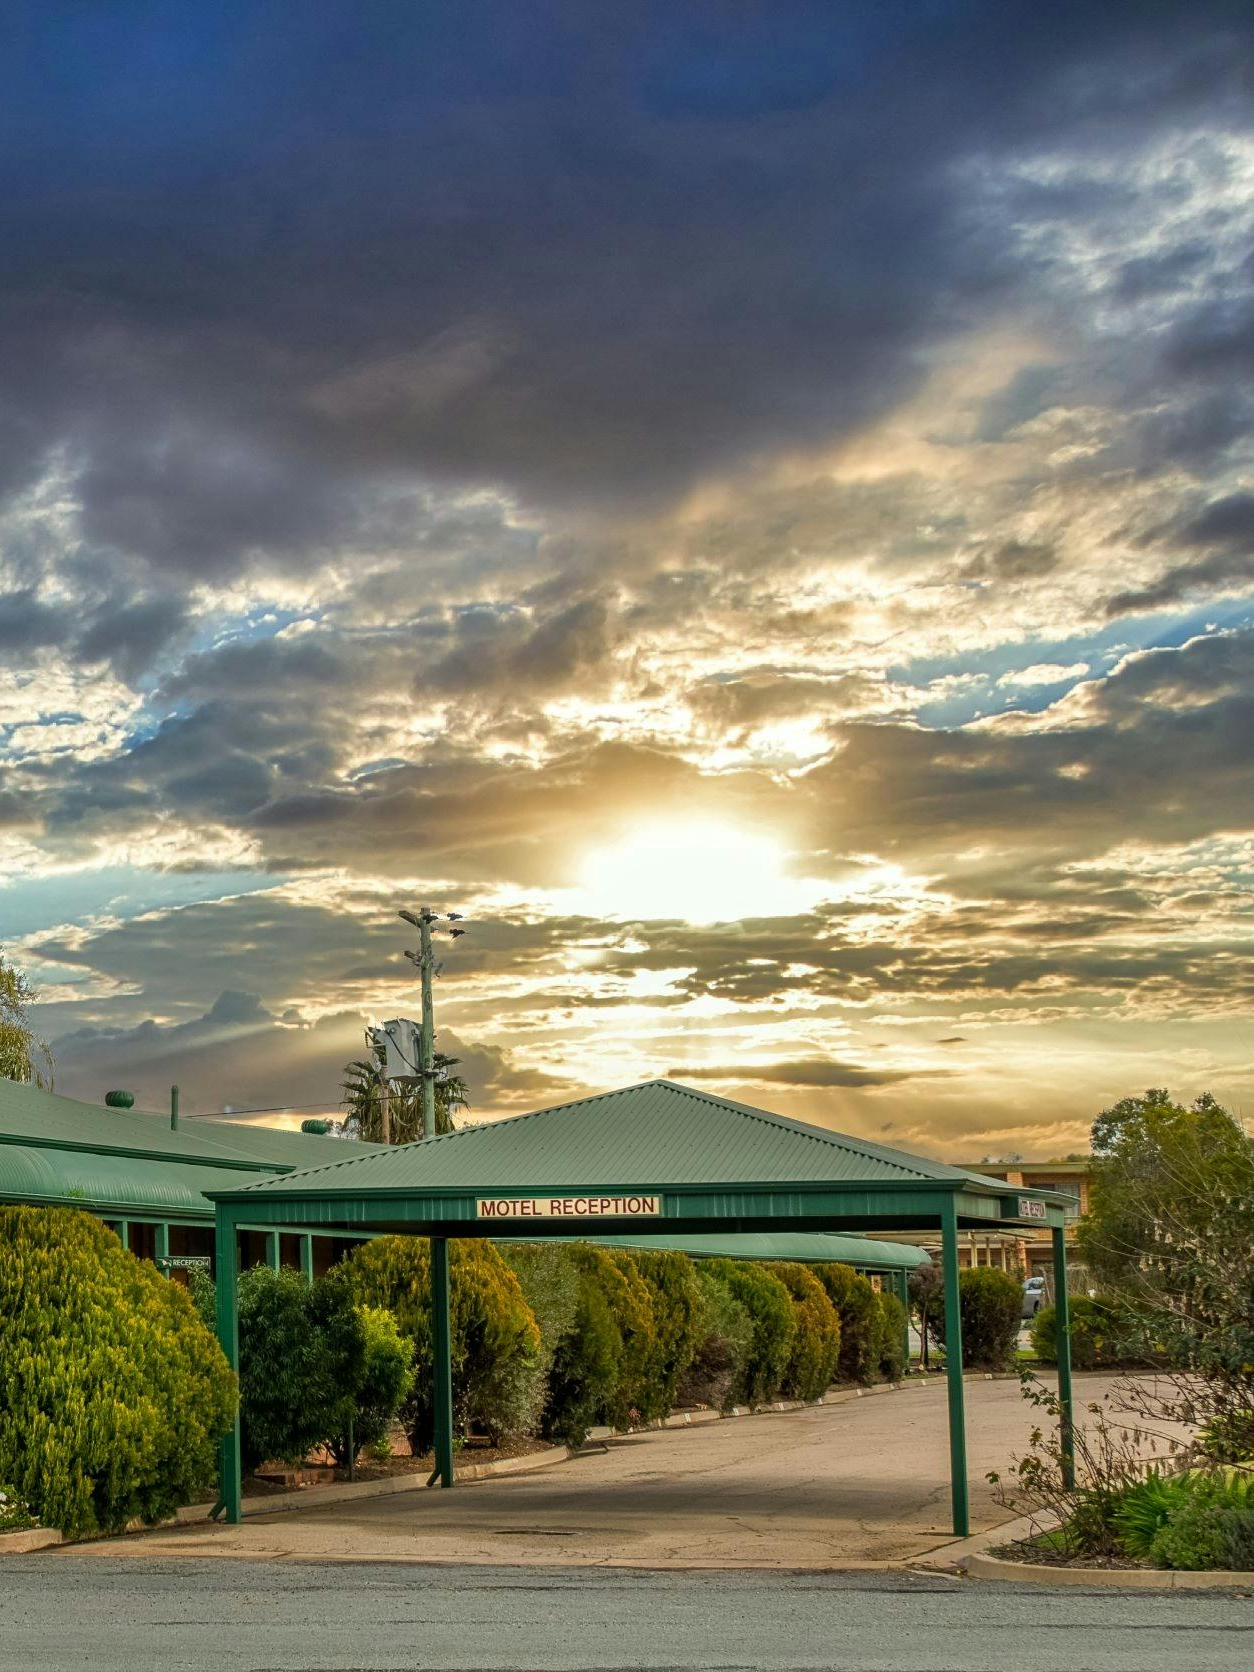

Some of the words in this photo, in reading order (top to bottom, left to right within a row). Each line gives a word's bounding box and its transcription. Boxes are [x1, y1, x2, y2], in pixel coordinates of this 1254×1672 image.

[481, 1200, 542, 1216] MOTEL
[550, 1197, 654, 1215] RECEPTION
[172, 1259, 209, 1267] RECEPTION
